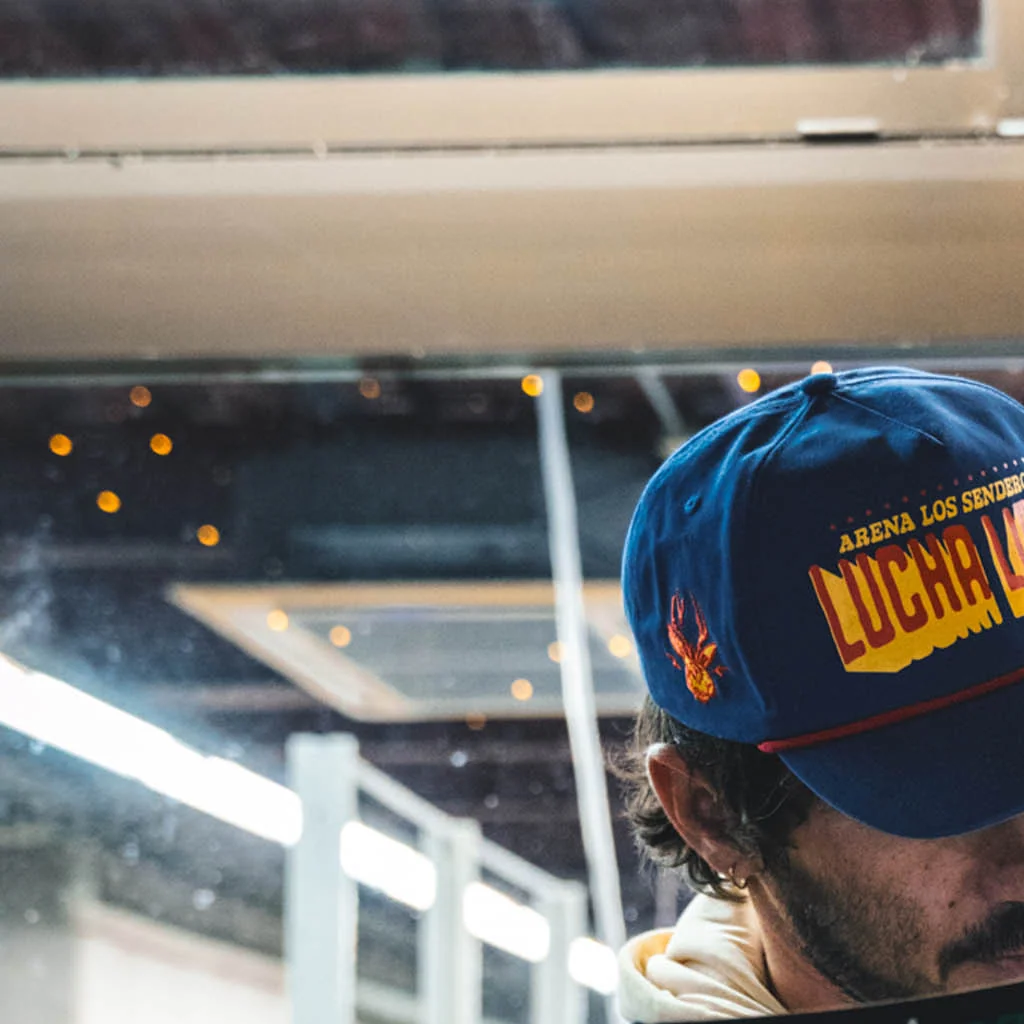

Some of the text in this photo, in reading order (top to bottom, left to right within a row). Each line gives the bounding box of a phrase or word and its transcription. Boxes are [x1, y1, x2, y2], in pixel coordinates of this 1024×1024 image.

[839, 513, 916, 553] ARENA
[920, 496, 959, 526] LOS
[808, 524, 1002, 672] LUCHA
